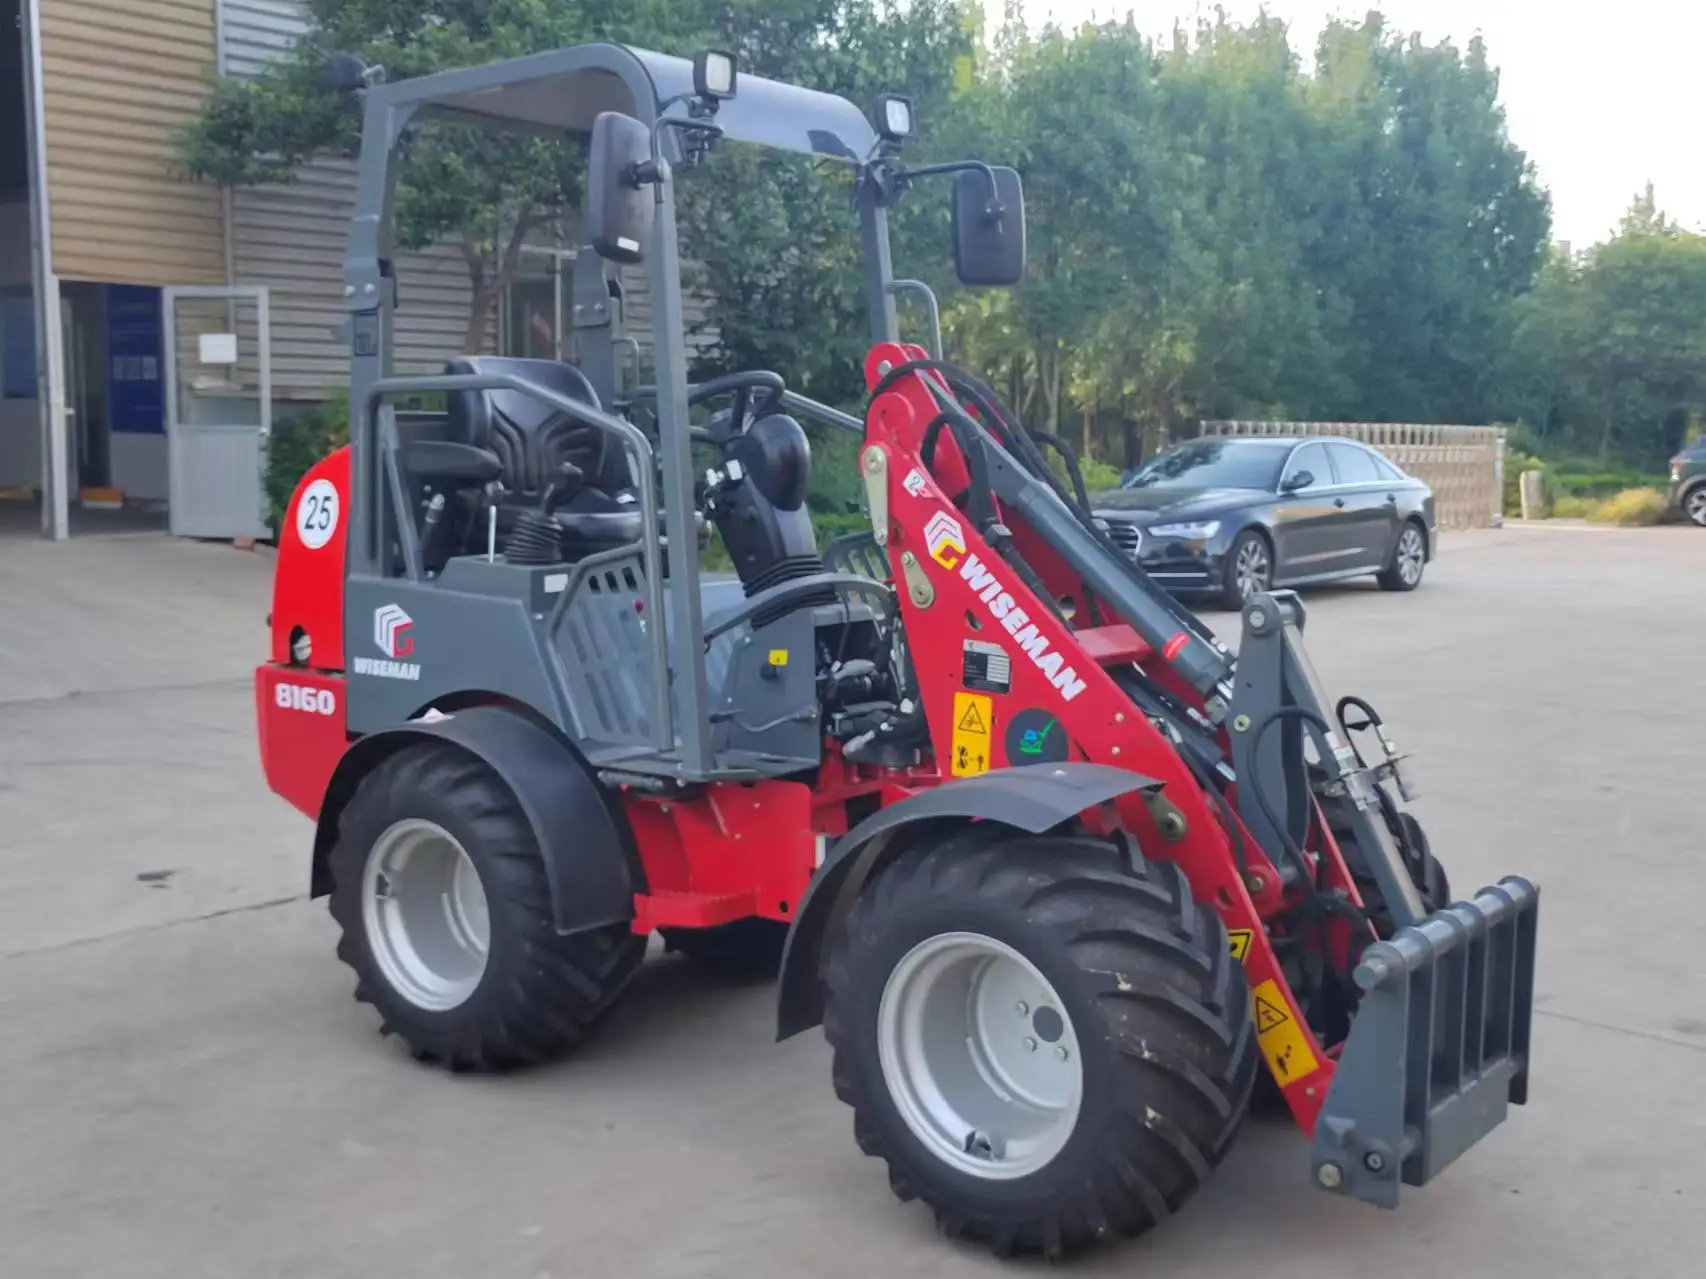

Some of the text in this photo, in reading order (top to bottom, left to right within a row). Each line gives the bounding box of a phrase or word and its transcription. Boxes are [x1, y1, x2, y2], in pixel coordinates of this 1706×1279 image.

[304, 495, 332, 531] 25
[959, 553, 1087, 701] WISEMAN
[353, 656, 421, 681] WISEMAN
